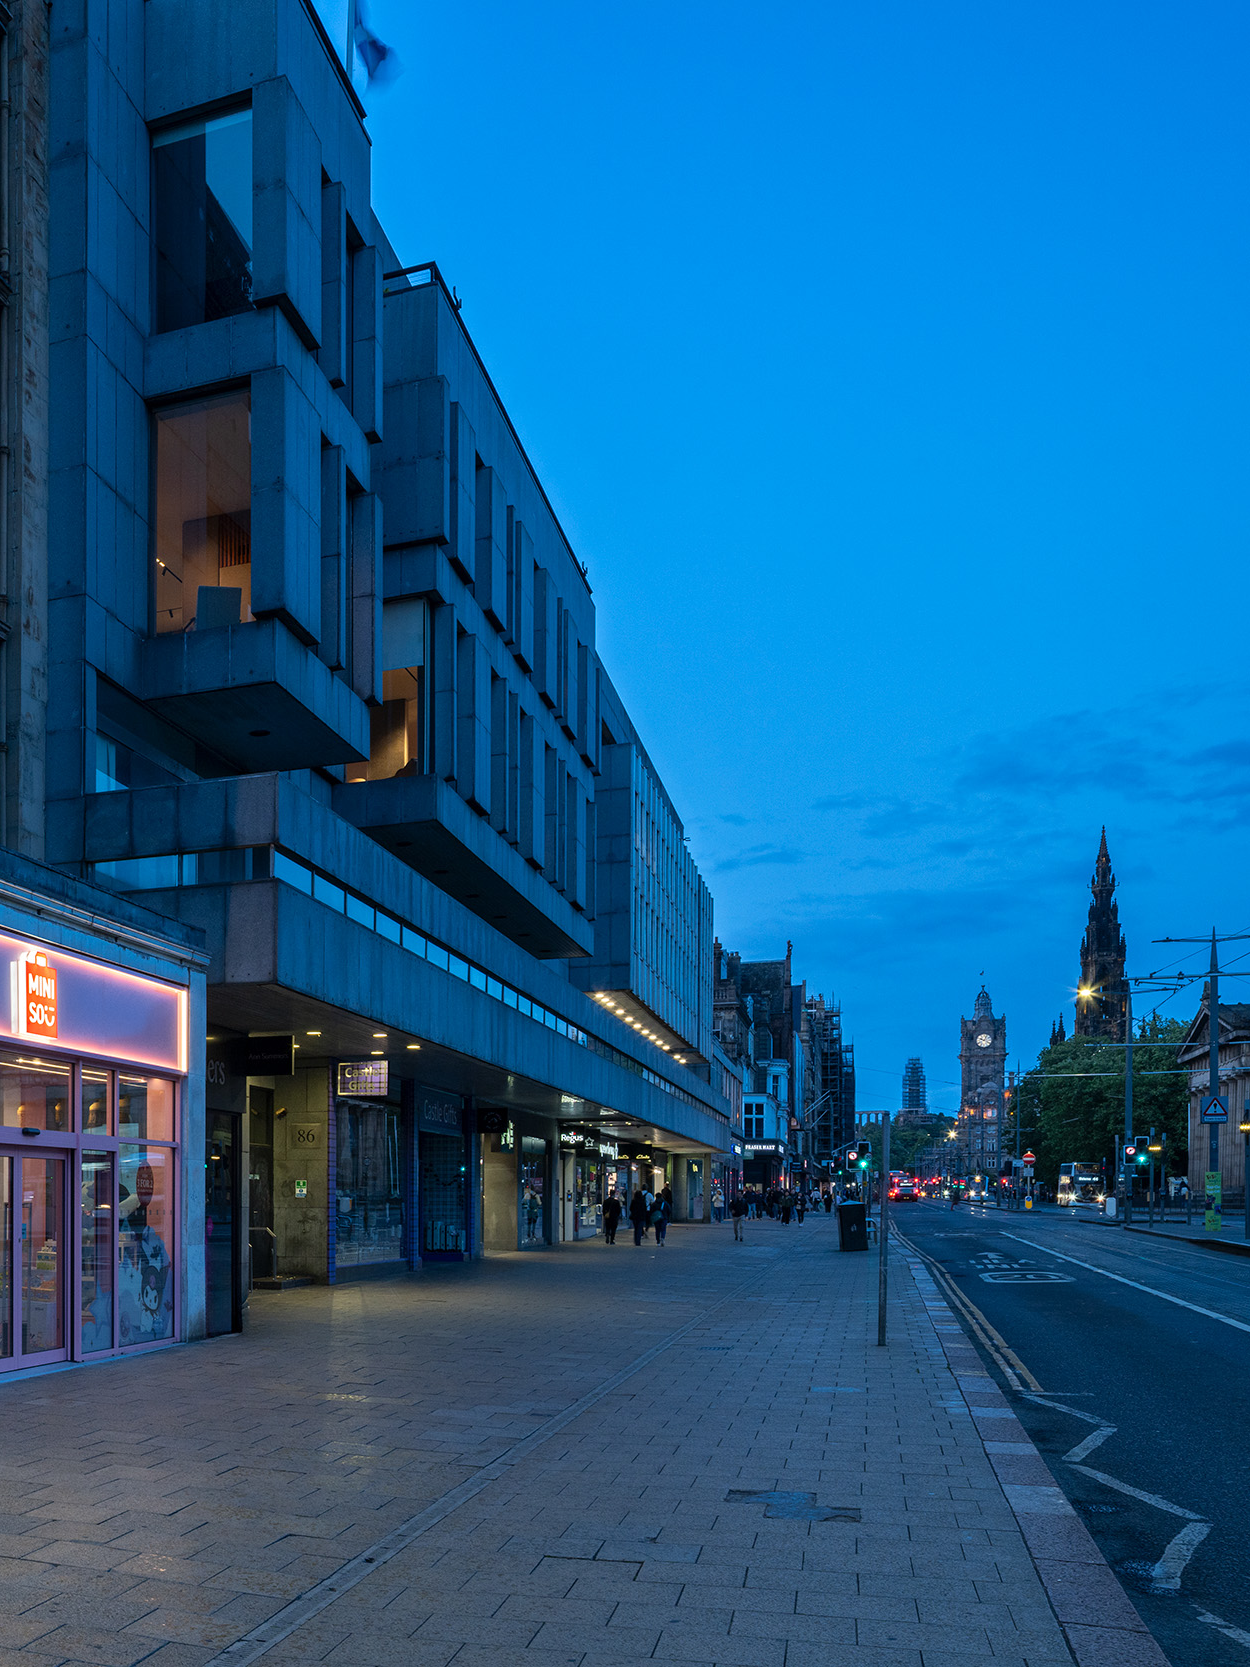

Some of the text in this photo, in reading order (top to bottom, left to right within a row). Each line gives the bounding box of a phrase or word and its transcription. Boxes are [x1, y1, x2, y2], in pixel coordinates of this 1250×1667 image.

[28, 972, 55, 1000] MINI
[344, 1066, 380, 1078] Castle
[348, 1080, 376, 1091] Gifts
[423, 1099, 443, 1123] Castle
[443, 1101, 458, 1126] Gifts
[297, 1129, 315, 1143] 86
[560, 1133, 584, 1144] Regus
